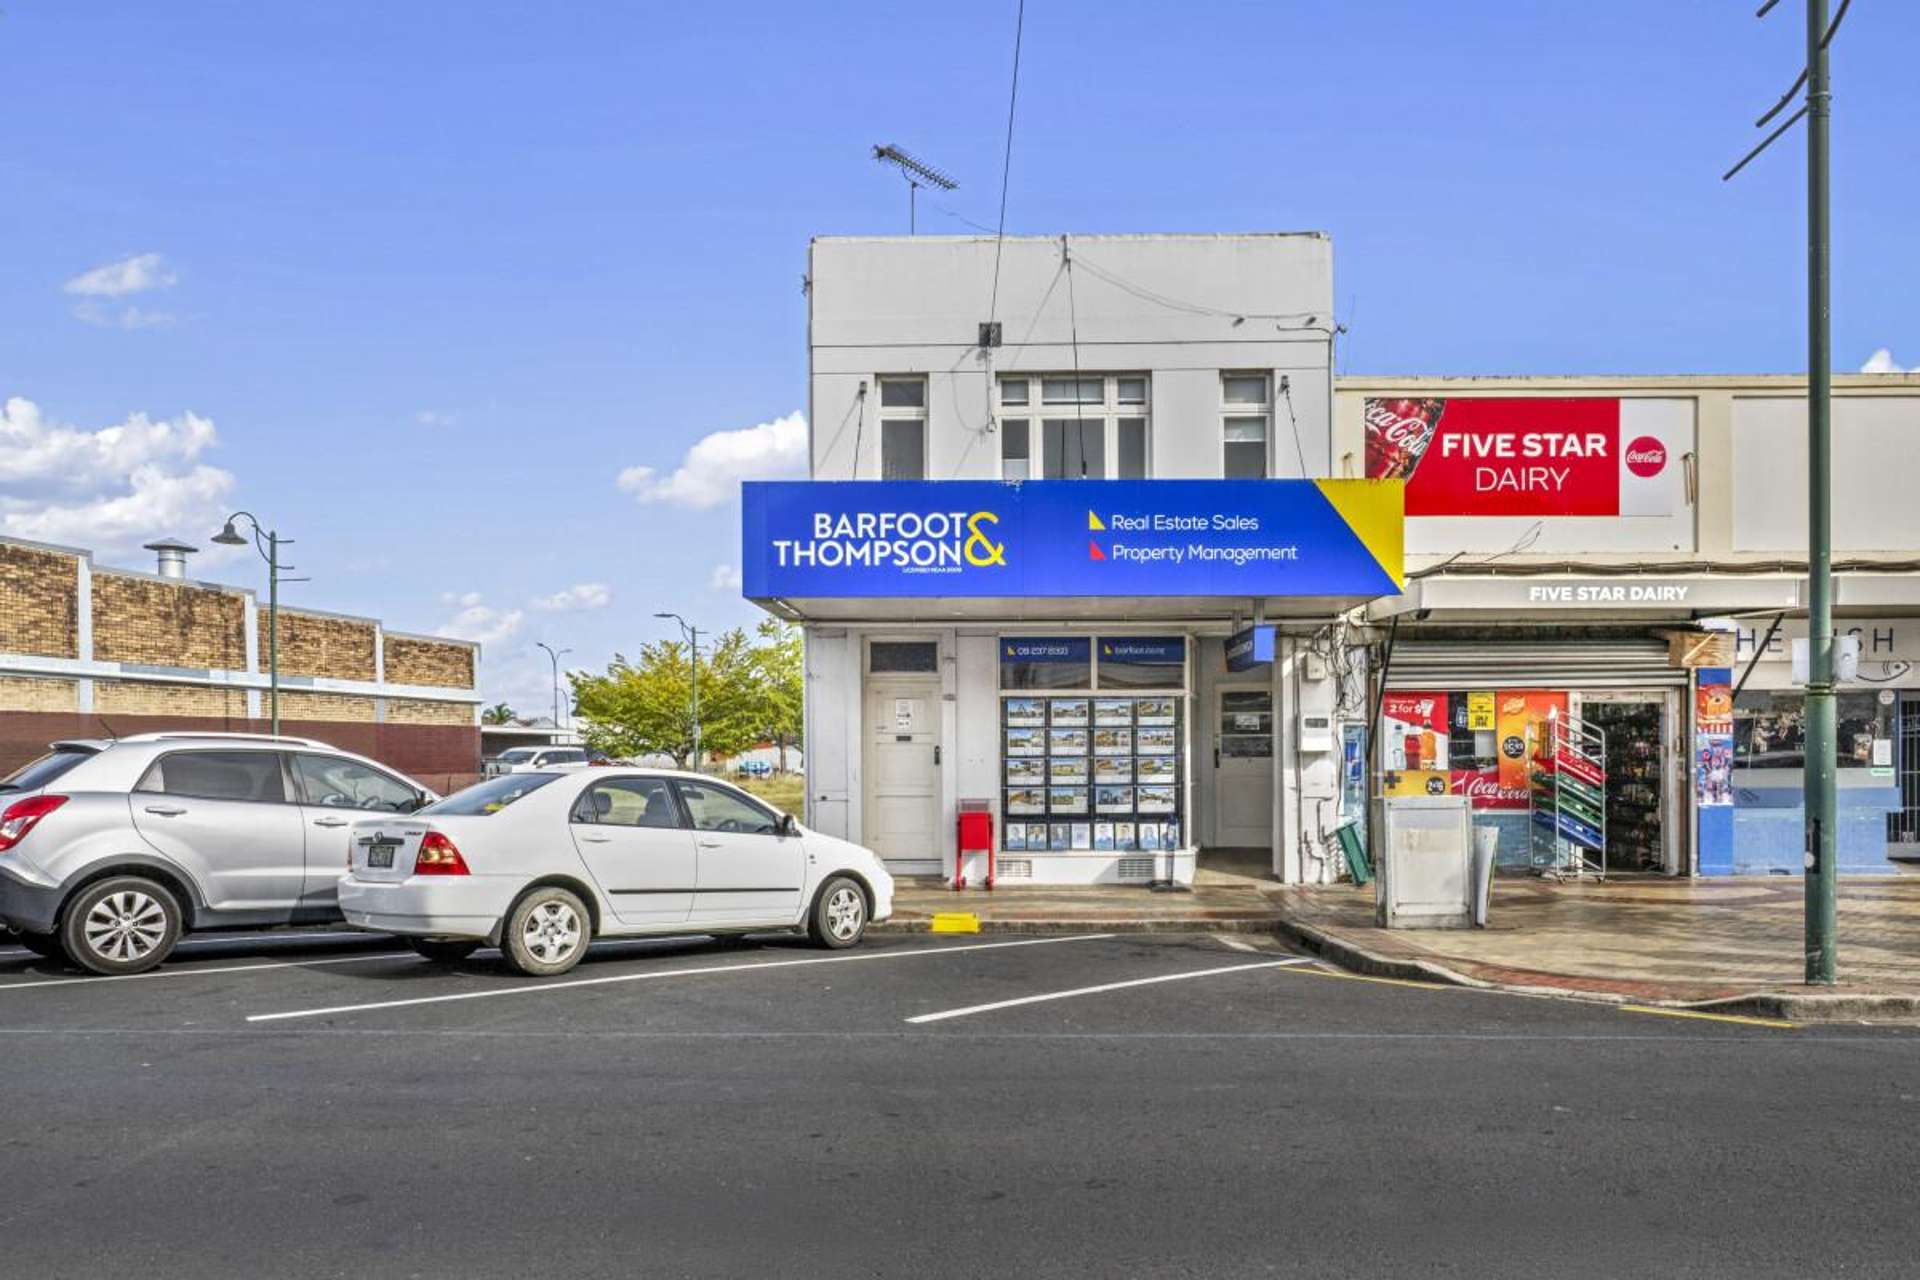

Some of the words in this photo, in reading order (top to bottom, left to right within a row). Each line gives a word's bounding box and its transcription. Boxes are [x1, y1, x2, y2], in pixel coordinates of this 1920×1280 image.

[1442, 433, 1515, 457] FIVE
[1521, 432, 1608, 457] STAR
[1476, 467, 1570, 491] DAIRY
[1112, 514, 1150, 530] Real
[1154, 515, 1208, 530] Estate
[1212, 515, 1259, 530] Sales
[813, 513, 967, 539] BARFOOT
[964, 511, 1006, 567] &
[773, 540, 961, 567] THOMPSON
[1112, 545, 1184, 563] Property
[1188, 545, 1298, 565] Management
[1530, 587, 1572, 601] FIVE
[1577, 587, 1625, 601] STAR
[1630, 587, 1688, 601] DAIRY
[1389, 703, 1398, 713] 2
[1398, 702, 1413, 713] for
